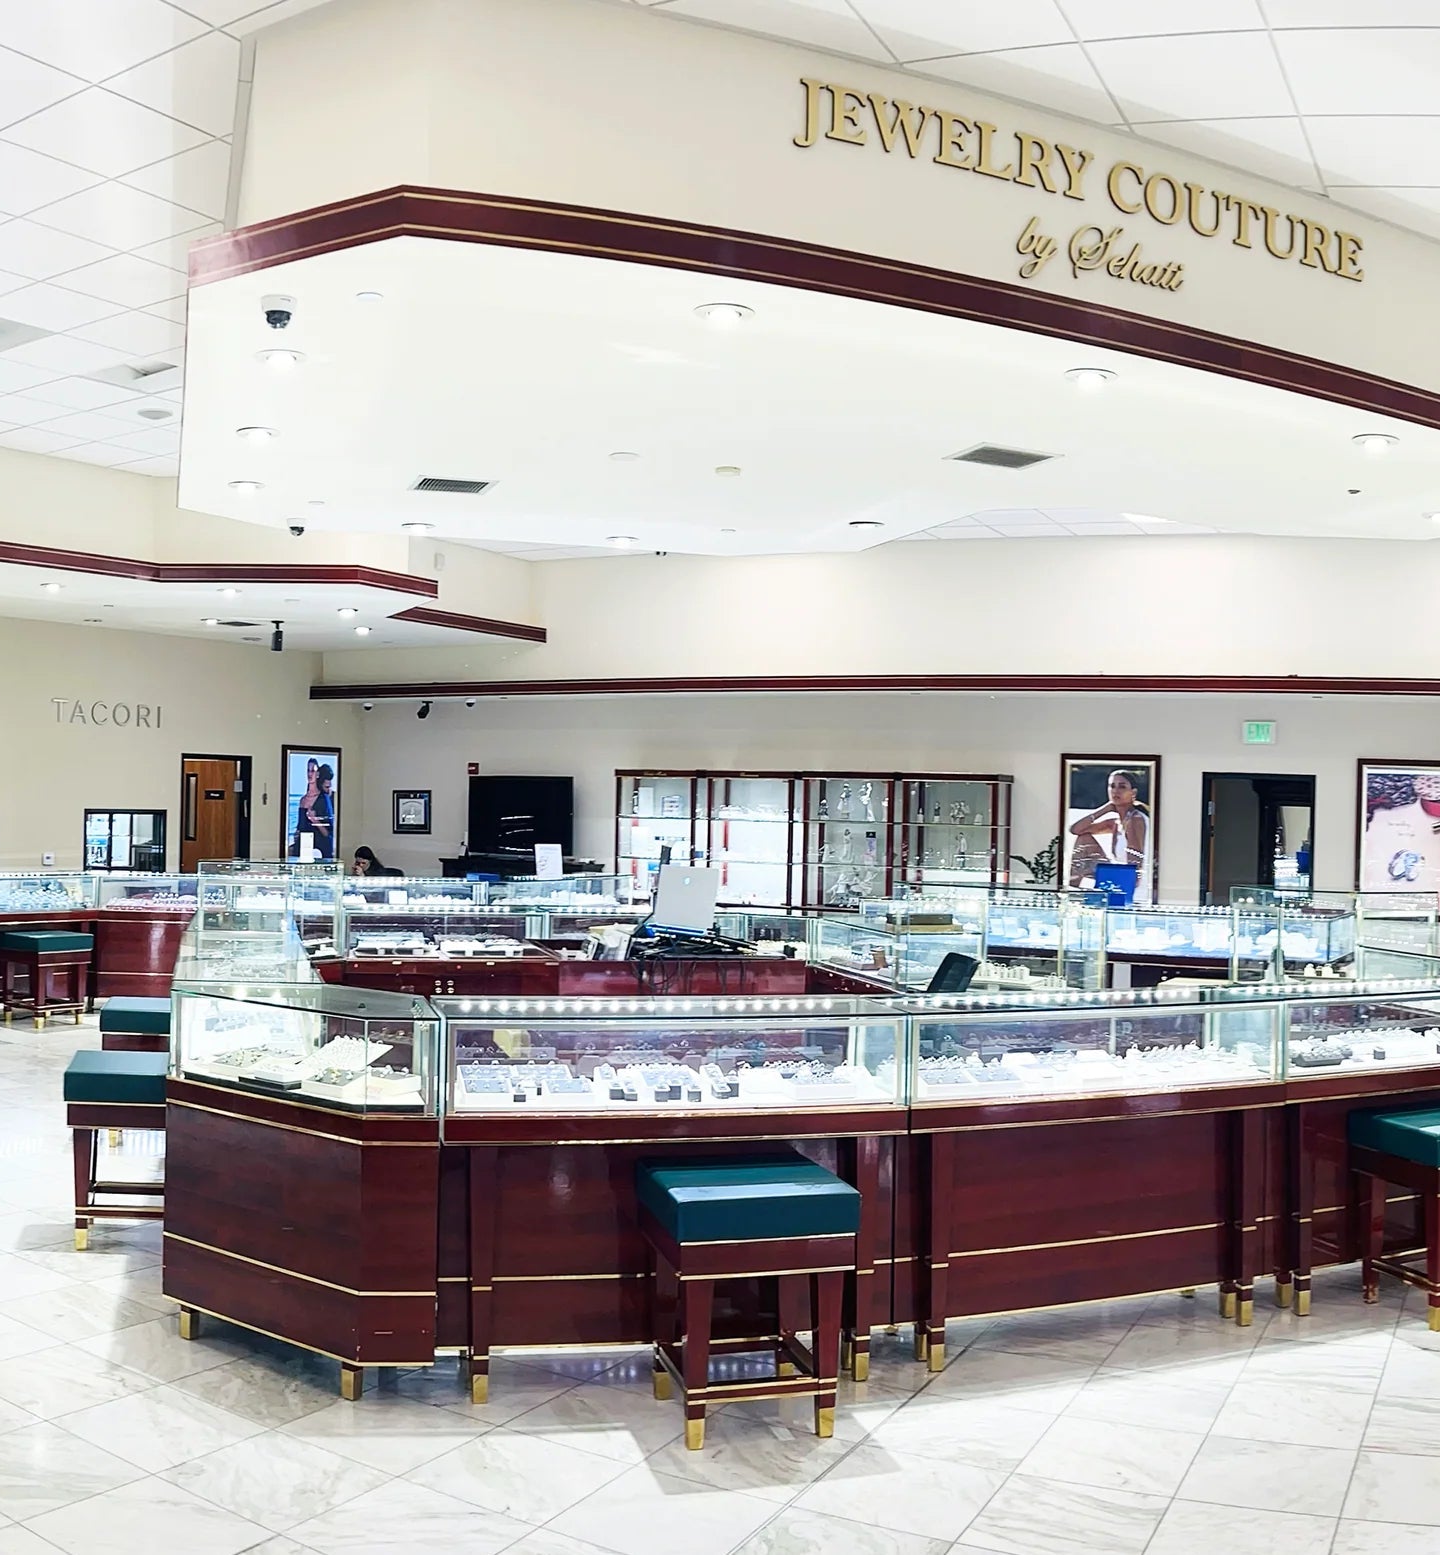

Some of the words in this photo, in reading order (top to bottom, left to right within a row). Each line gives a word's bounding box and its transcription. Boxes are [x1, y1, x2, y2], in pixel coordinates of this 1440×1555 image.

[793, 77, 1094, 201] JEWELRY
[1107, 160, 1365, 282] COUTURE
[1016, 216, 1057, 279] by
[51, 698, 161, 728] TACORI
